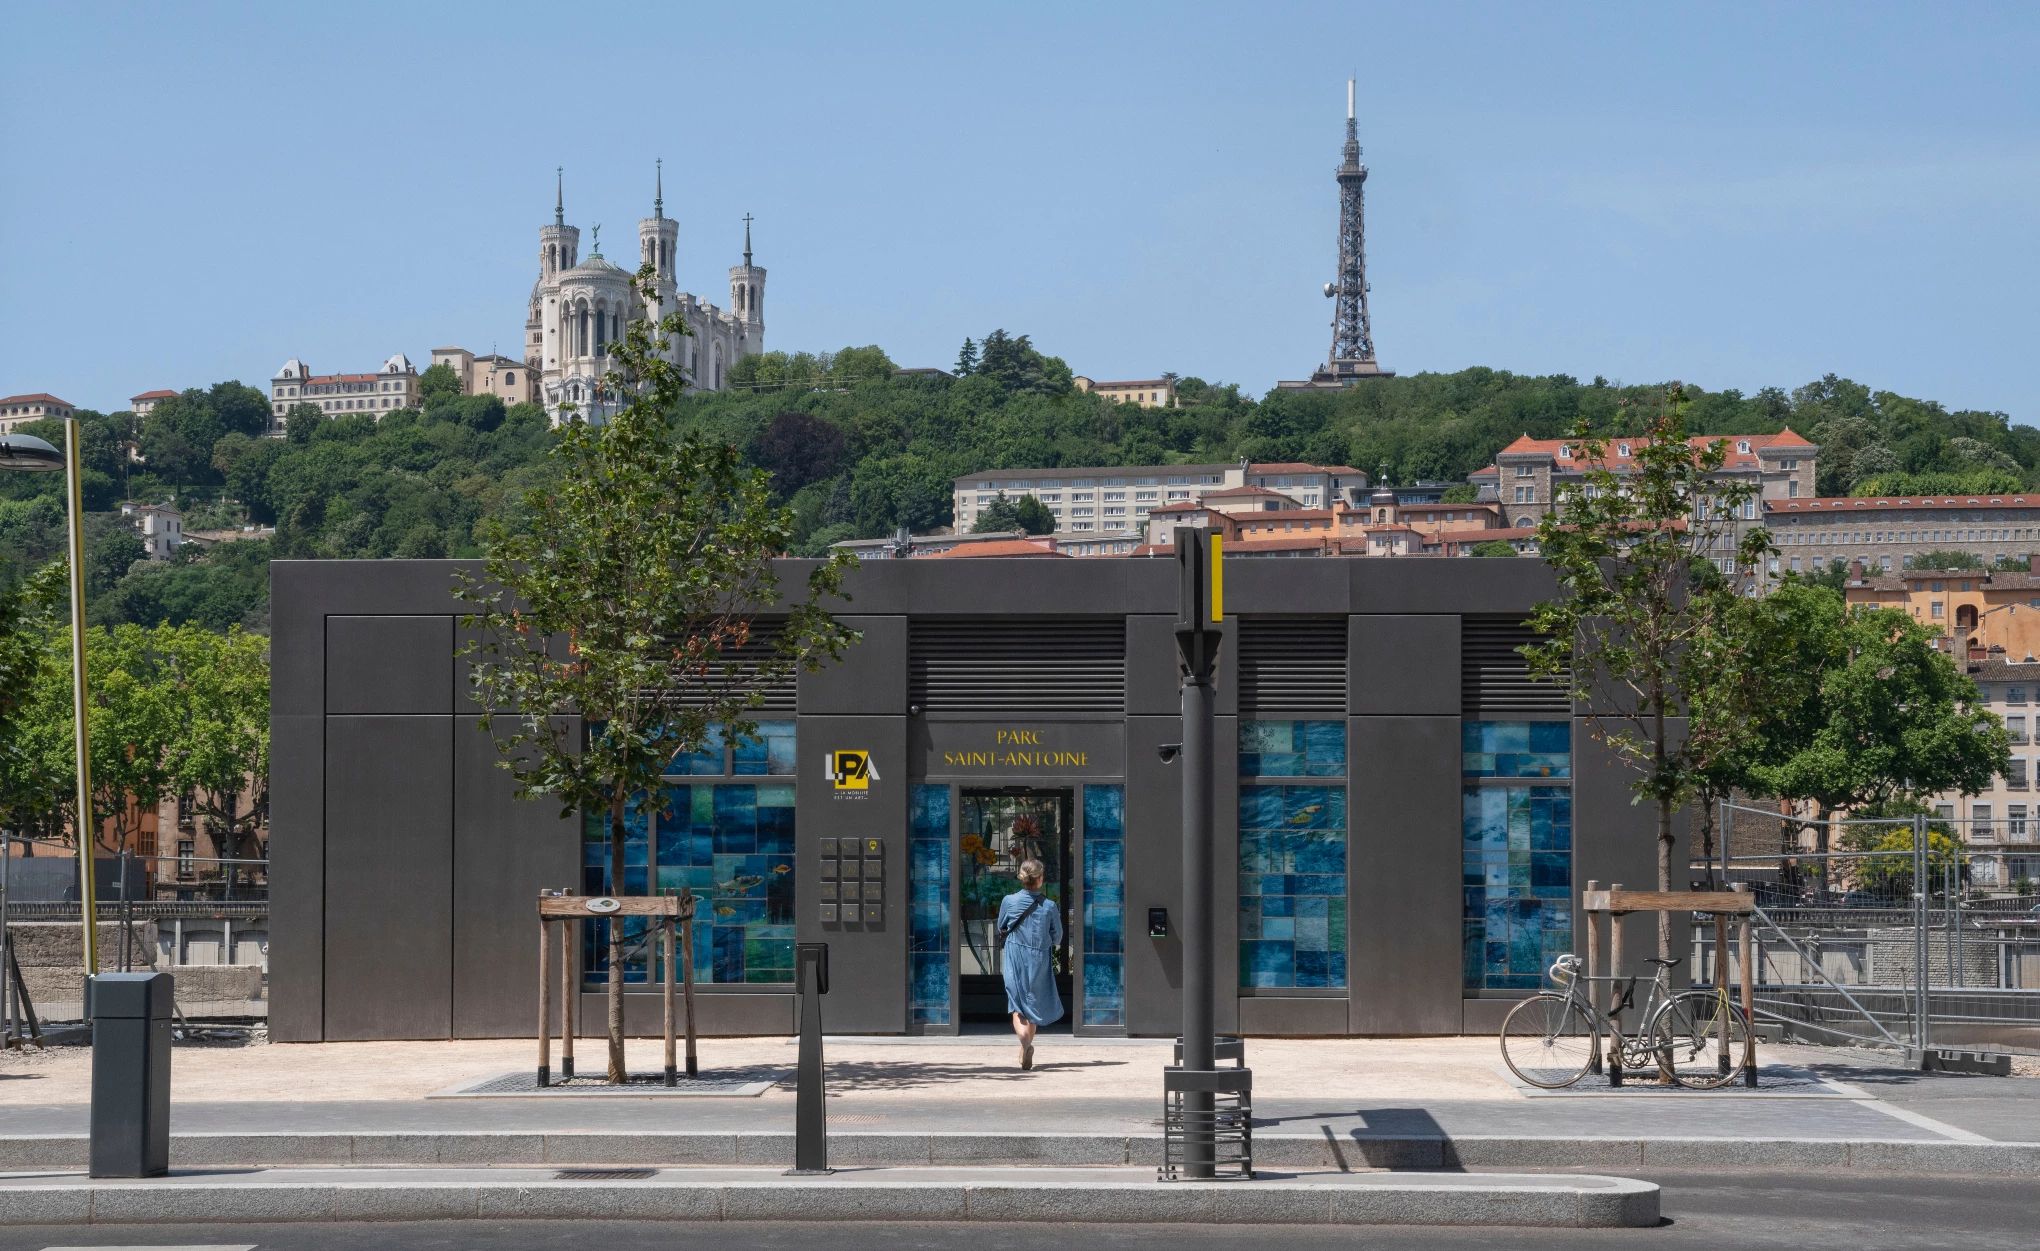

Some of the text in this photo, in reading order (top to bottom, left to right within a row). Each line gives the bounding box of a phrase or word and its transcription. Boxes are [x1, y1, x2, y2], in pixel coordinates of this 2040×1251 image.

[997, 730, 1045, 745] PARC
[944, 751, 1090, 766] SAINT-ANTOINE
[825, 753, 881, 786] LPA
